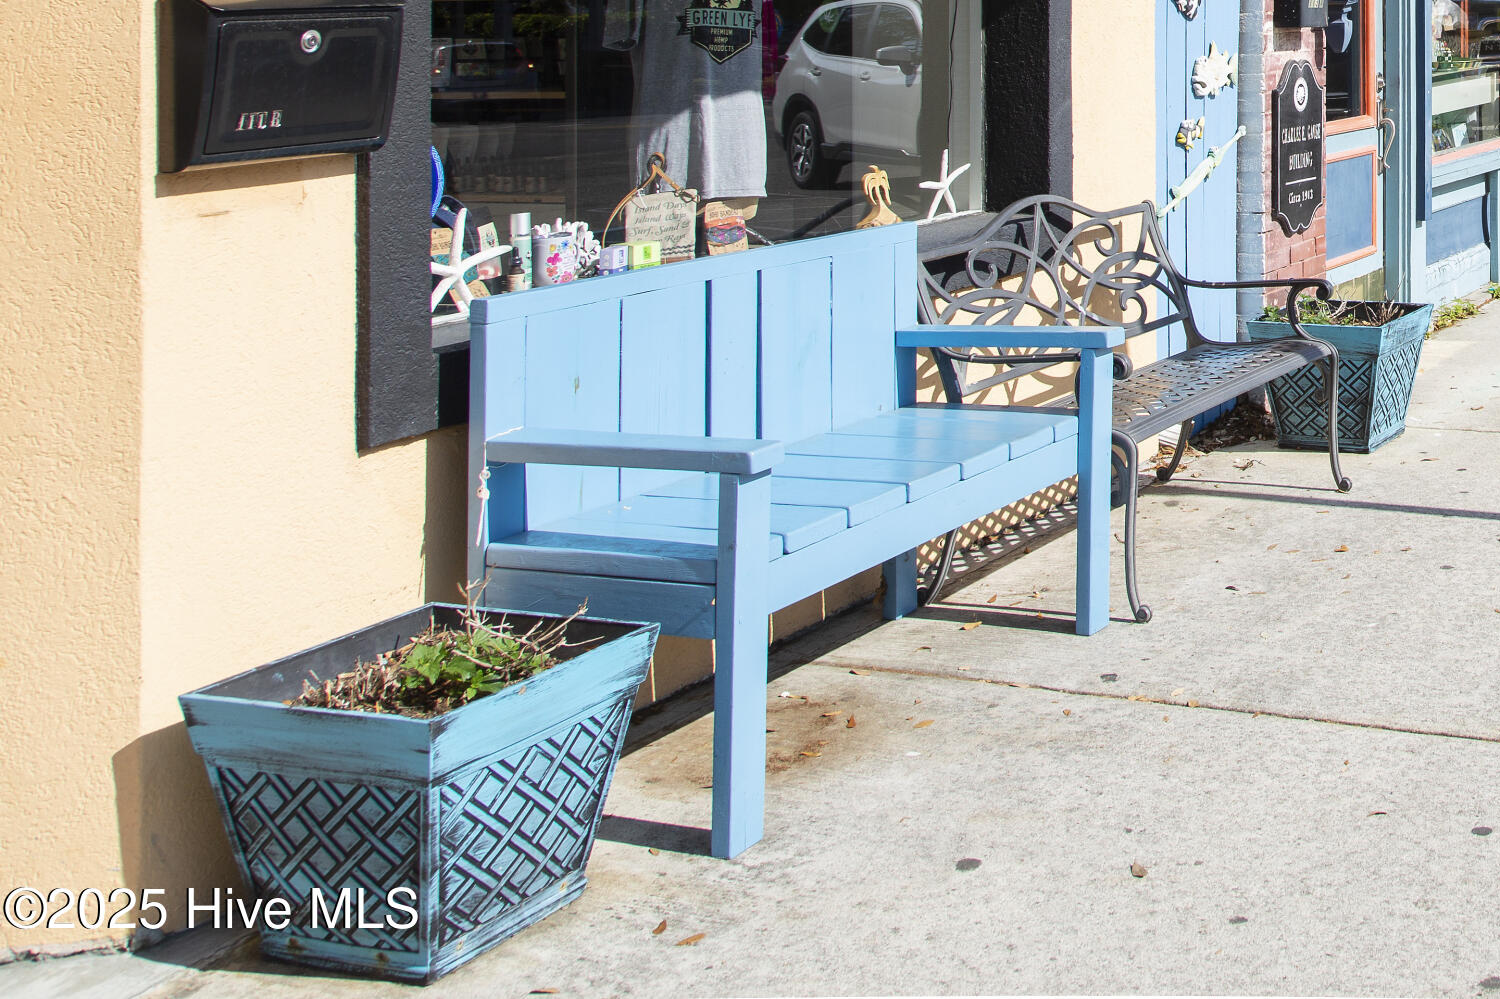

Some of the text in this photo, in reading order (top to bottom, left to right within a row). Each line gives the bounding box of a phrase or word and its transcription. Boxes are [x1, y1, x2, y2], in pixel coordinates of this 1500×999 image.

[692, 10, 753, 28] GREEN LYF
[710, 27, 733, 36] PREMIUM
[709, 45, 735, 53] PRODUCTS
[1282, 126, 1302, 145] CHARLES
[1288, 151, 1313, 171] BUILDING
[1288, 191, 1301, 204] Circa
